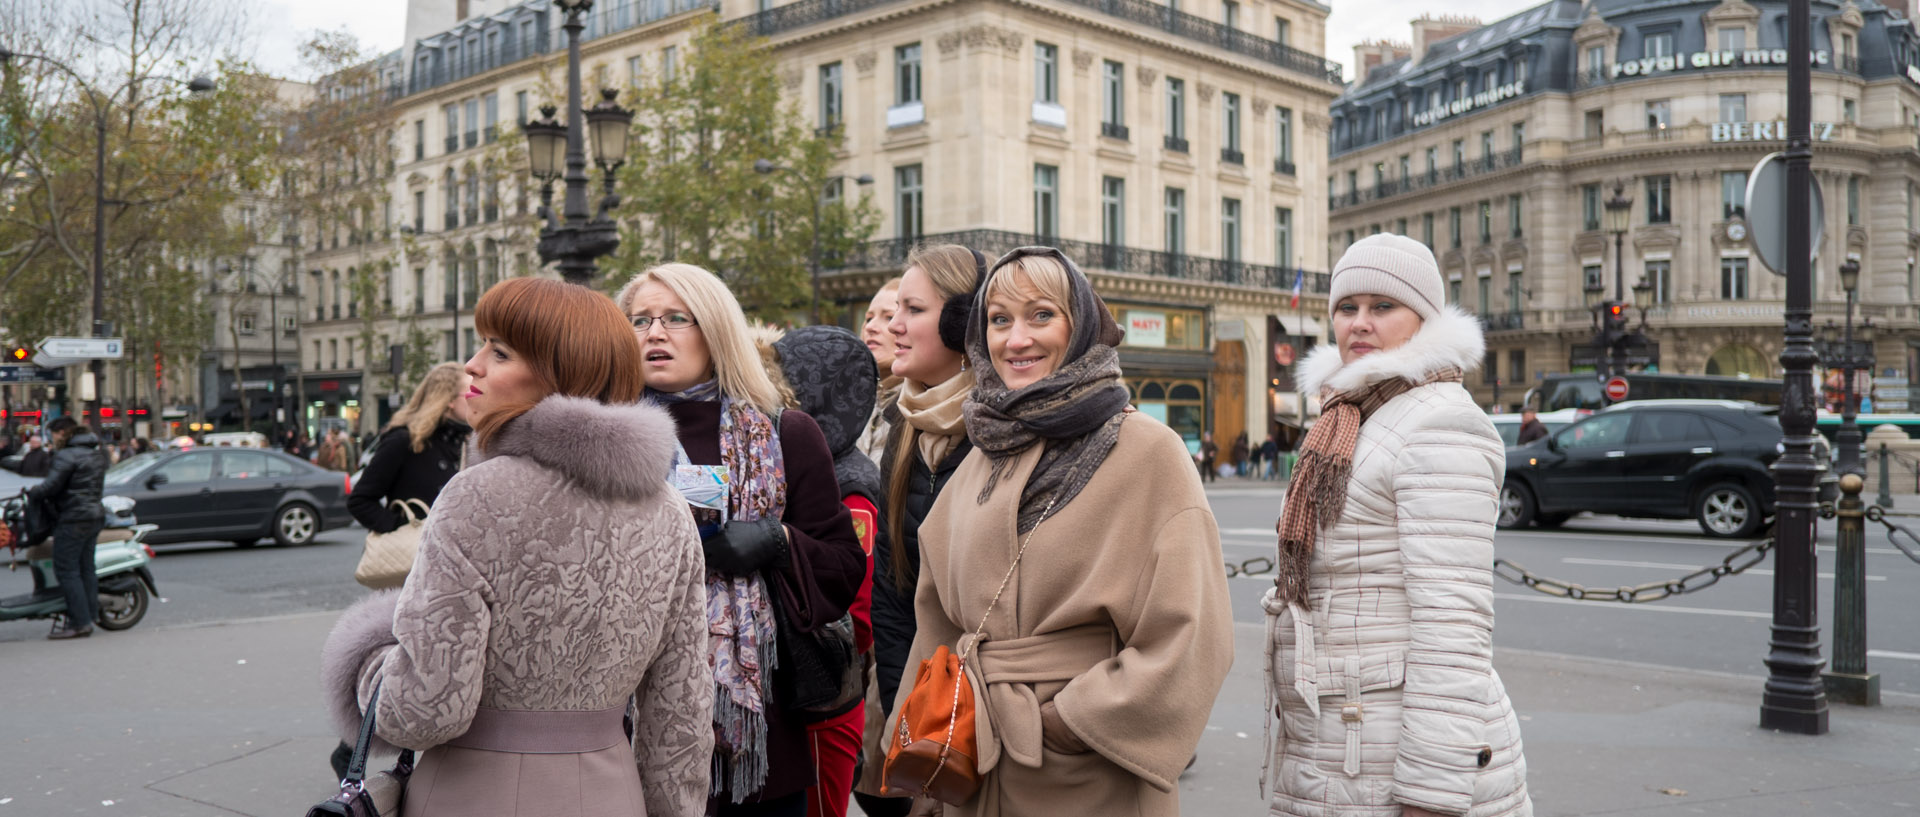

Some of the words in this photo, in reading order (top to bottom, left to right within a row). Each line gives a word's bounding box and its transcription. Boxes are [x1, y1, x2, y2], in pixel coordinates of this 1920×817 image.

[1611, 52, 1685, 78] royal
[1691, 51, 1735, 68] air
[1743, 50, 1829, 66] mac
[1414, 102, 1451, 127] royal
[1451, 97, 1473, 115] air
[1474, 80, 1525, 107] maroc
[1711, 121, 1835, 142] BERLZ
[1132, 319, 1161, 330] MATY
